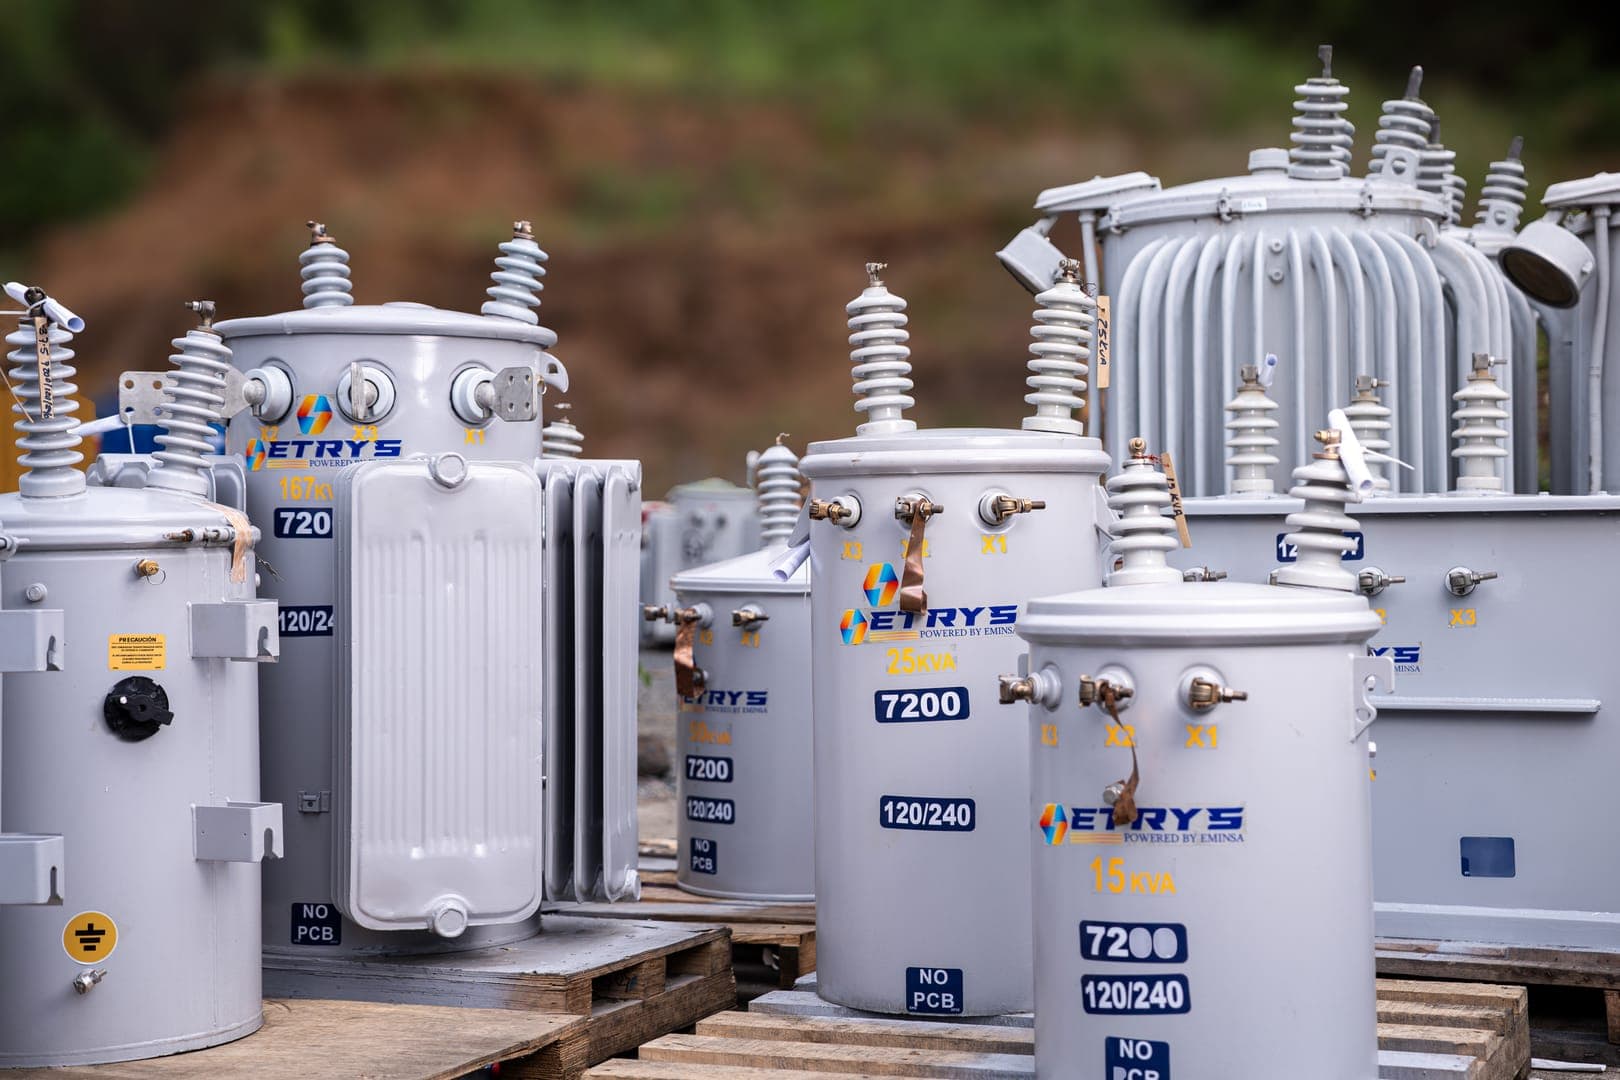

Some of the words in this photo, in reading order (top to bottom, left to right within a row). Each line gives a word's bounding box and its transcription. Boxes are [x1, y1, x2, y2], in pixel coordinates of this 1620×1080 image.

[352, 425, 379, 442] X3
[463, 427, 485, 446] X1
[268, 440, 402, 458] ETRYS
[279, 511, 331, 535] 720
[842, 541, 863, 560] X3
[981, 534, 1008, 555] X1
[869, 605, 1018, 630] ETRYS
[1450, 608, 1476, 625] X3
[920, 629, 968, 639] POWERED
[970, 628, 982, 637] BY
[984, 626, 1017, 636] EMINS
[1394, 665, 1421, 673] MINSA
[881, 691, 961, 719] 7200
[1104, 724, 1138, 747] X2
[1185, 724, 1218, 748] X1
[687, 758, 729, 780] 7200
[687, 799, 733, 820] 120/240
[884, 800, 972, 827] 120/240
[1071, 807, 1244, 831] ETRYS
[694, 840, 710, 853] NO
[1124, 833, 1180, 844] POWERED
[1182, 833, 1198, 844] BY
[1200, 833, 1245, 844] EMINSA
[692, 856, 713, 871] PCB
[303, 904, 329, 919] NO
[298, 925, 334, 941] PCB
[1085, 925, 1178, 959] 7200
[919, 968, 949, 985] NO
[913, 991, 955, 1009] PCB
[1085, 980, 1184, 1010] 120/240
[1119, 1038, 1153, 1060] NO
